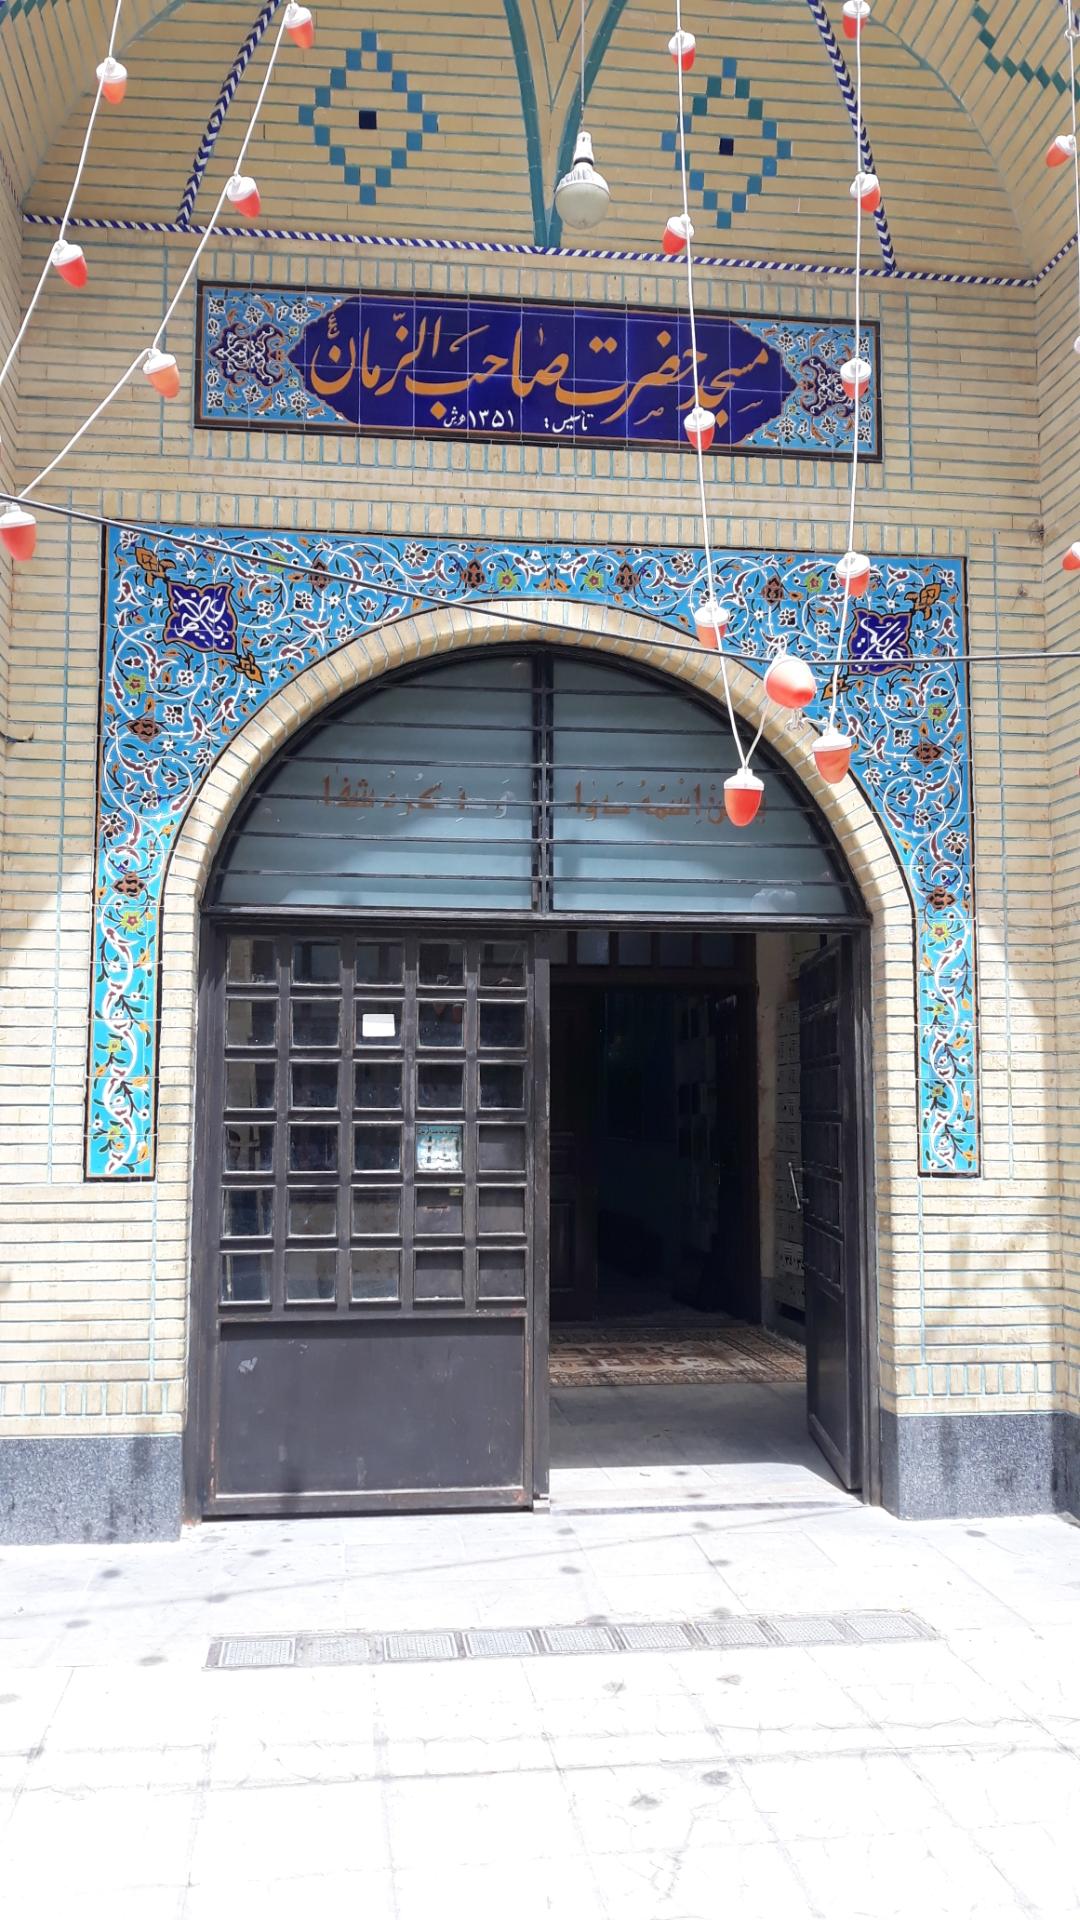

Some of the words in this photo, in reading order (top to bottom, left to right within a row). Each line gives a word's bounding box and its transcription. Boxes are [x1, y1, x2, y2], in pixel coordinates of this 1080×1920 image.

[404, 326, 569, 420] صاحب
[553, 329, 708, 425] حضرت
[675, 347, 769, 428] مسجد
[467, 408, 515, 429] ۱۳۵۱
